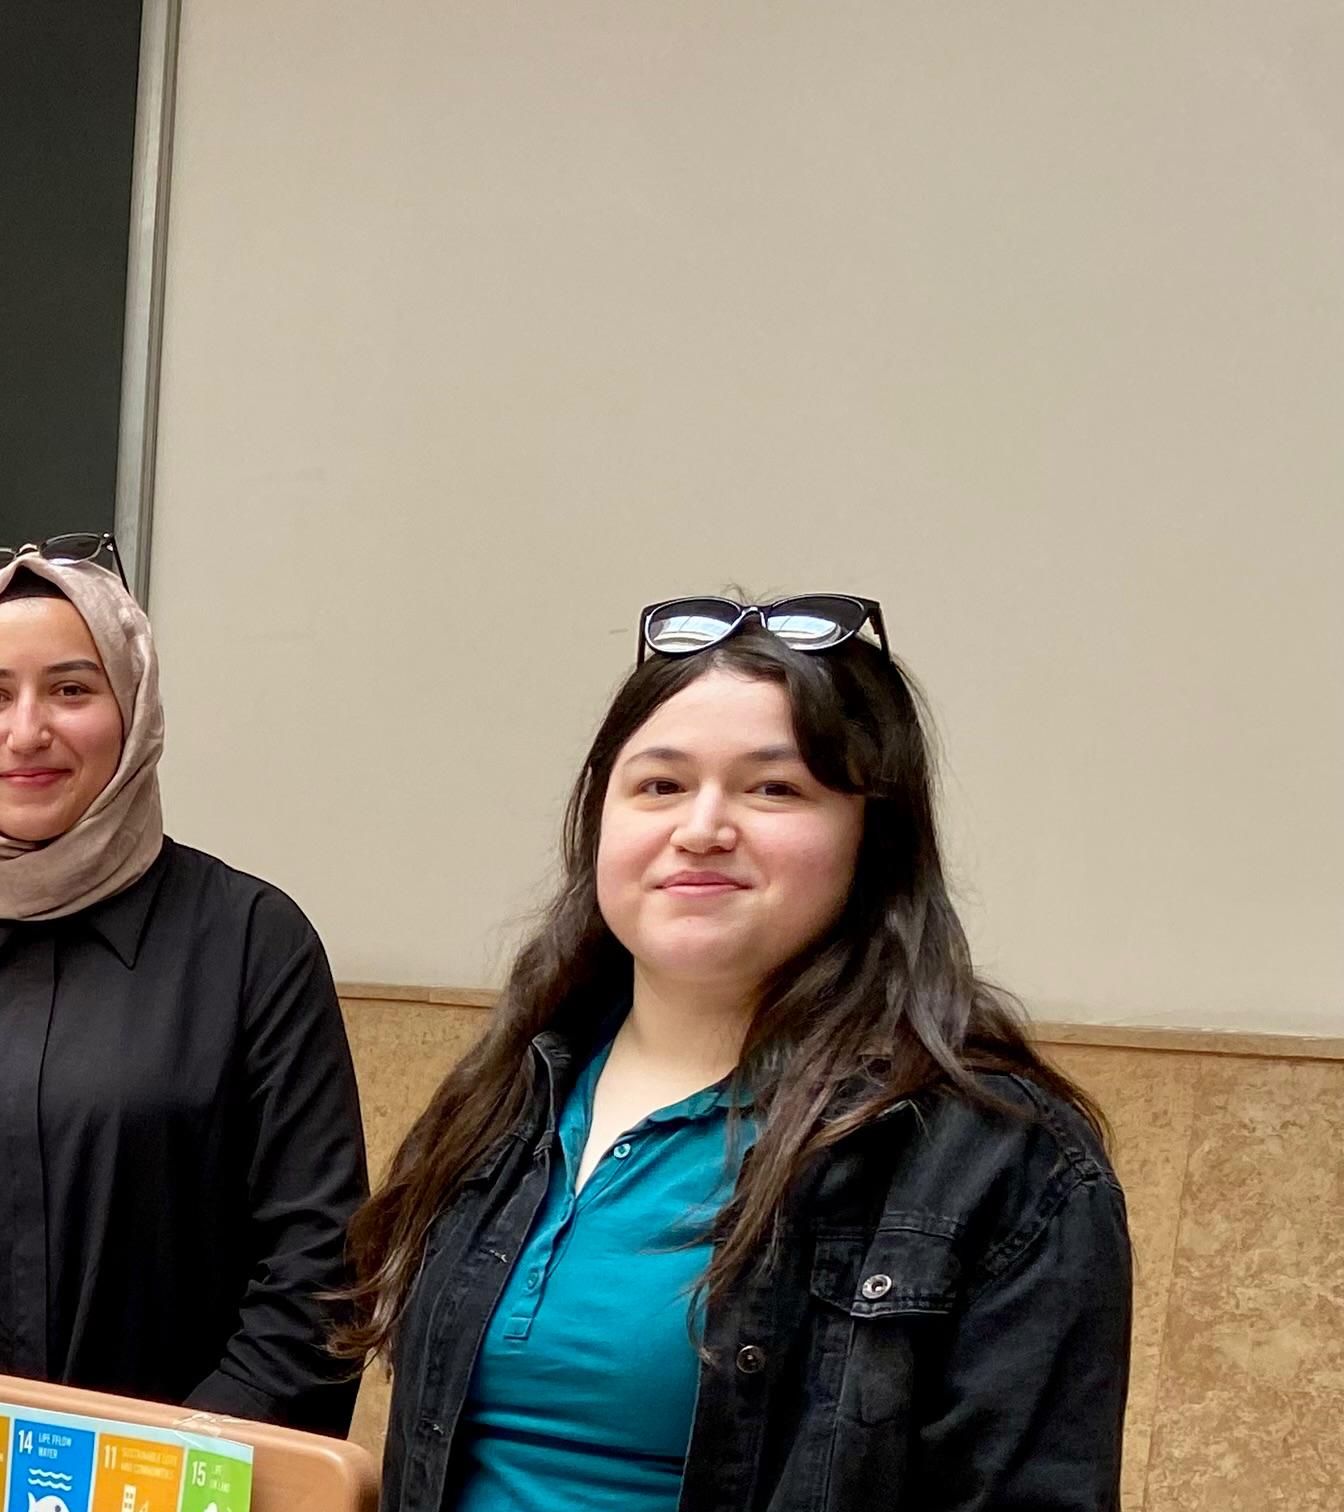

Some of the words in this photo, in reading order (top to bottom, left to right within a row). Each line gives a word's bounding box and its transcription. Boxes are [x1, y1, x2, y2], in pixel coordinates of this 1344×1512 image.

[18, 1429, 32, 1453] 14
[104, 1444, 117, 1469] 11
[191, 1460, 206, 1486] 15
